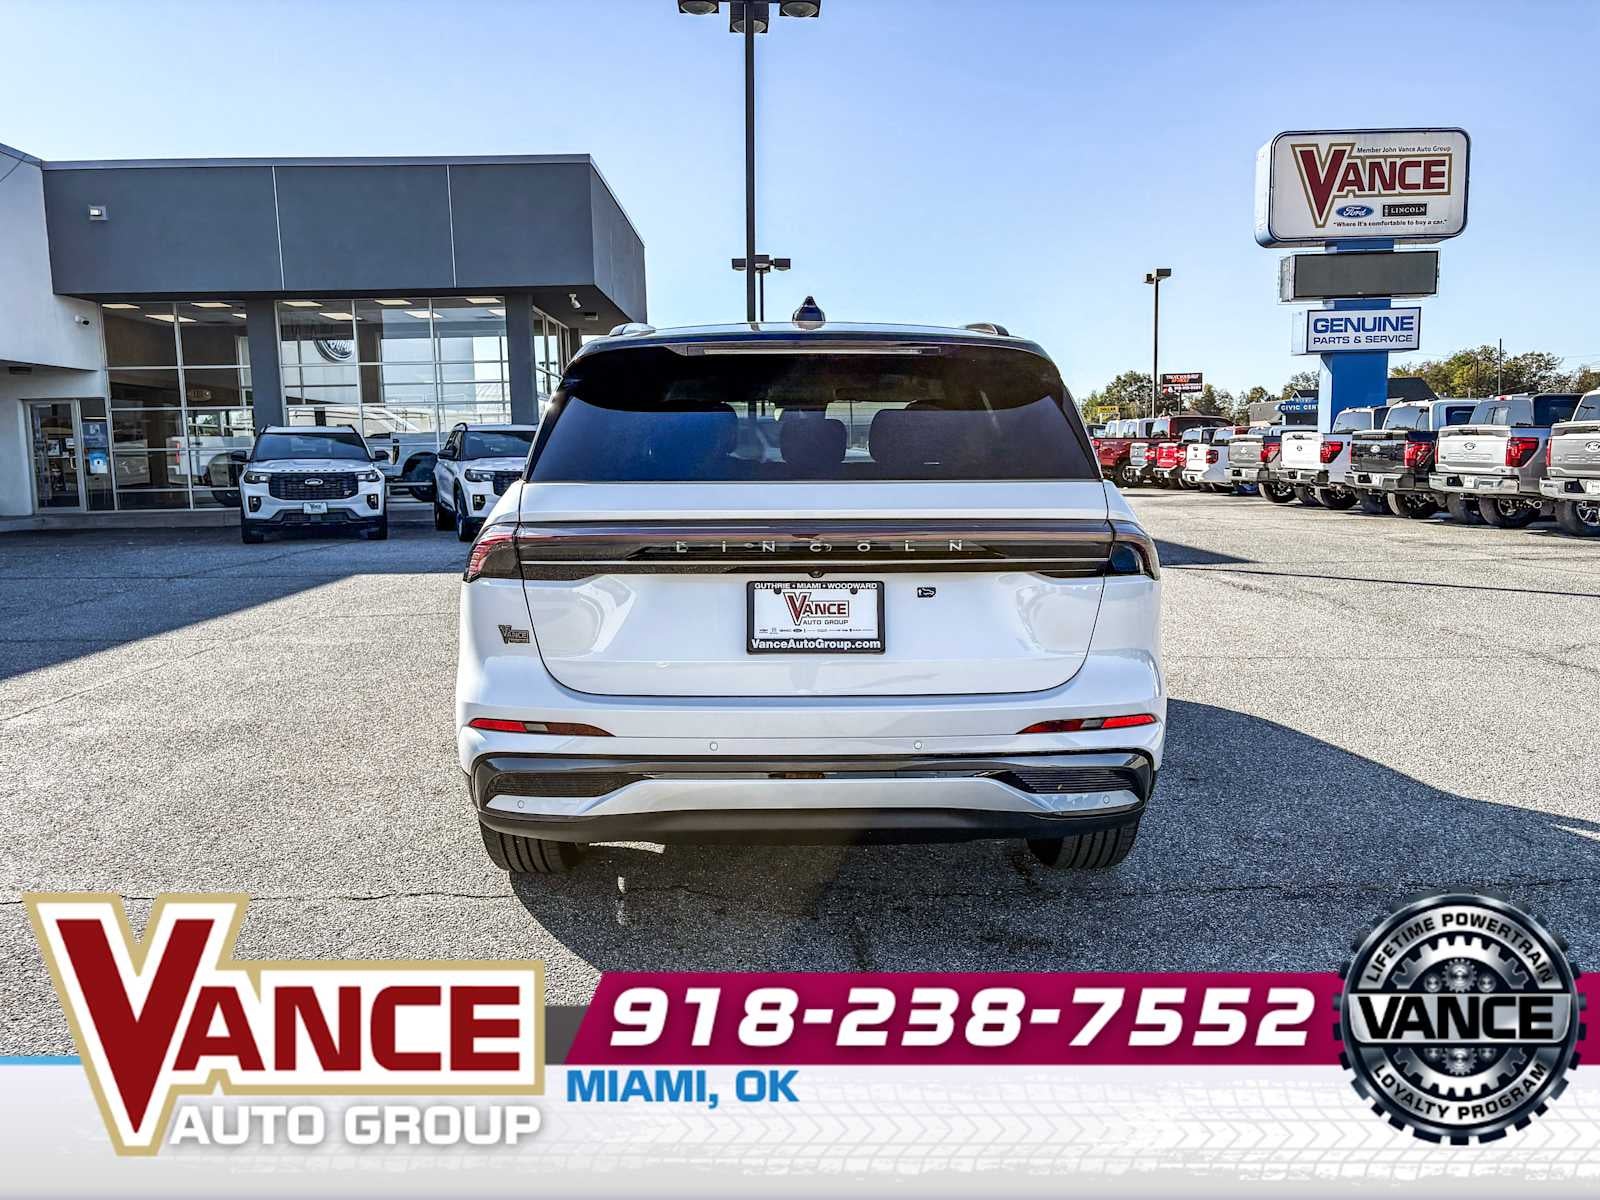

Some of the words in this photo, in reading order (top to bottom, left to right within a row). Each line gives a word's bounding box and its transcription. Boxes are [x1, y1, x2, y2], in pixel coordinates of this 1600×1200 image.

[1357, 146, 1382, 154] Member
[1433, 145, 1452, 153] Group
[1299, 149, 1446, 222] VANCE
[1342, 206, 1368, 216] Ford
[1415, 219, 1427, 227] buy
[1313, 315, 1414, 334] GENUINE
[1313, 336, 1350, 345] PARTS
[1353, 335, 1361, 344] &
[1365, 334, 1413, 344] SERVICE
[676, 539, 963, 553] LINCOLN
[754, 582, 790, 590] GUTHRIE
[796, 582, 822, 590] MIAMI
[827, 582, 878, 590] WOODWARD
[786, 594, 848, 624] VANCE
[751, 639, 881, 650] VanceAutoGroup.com
